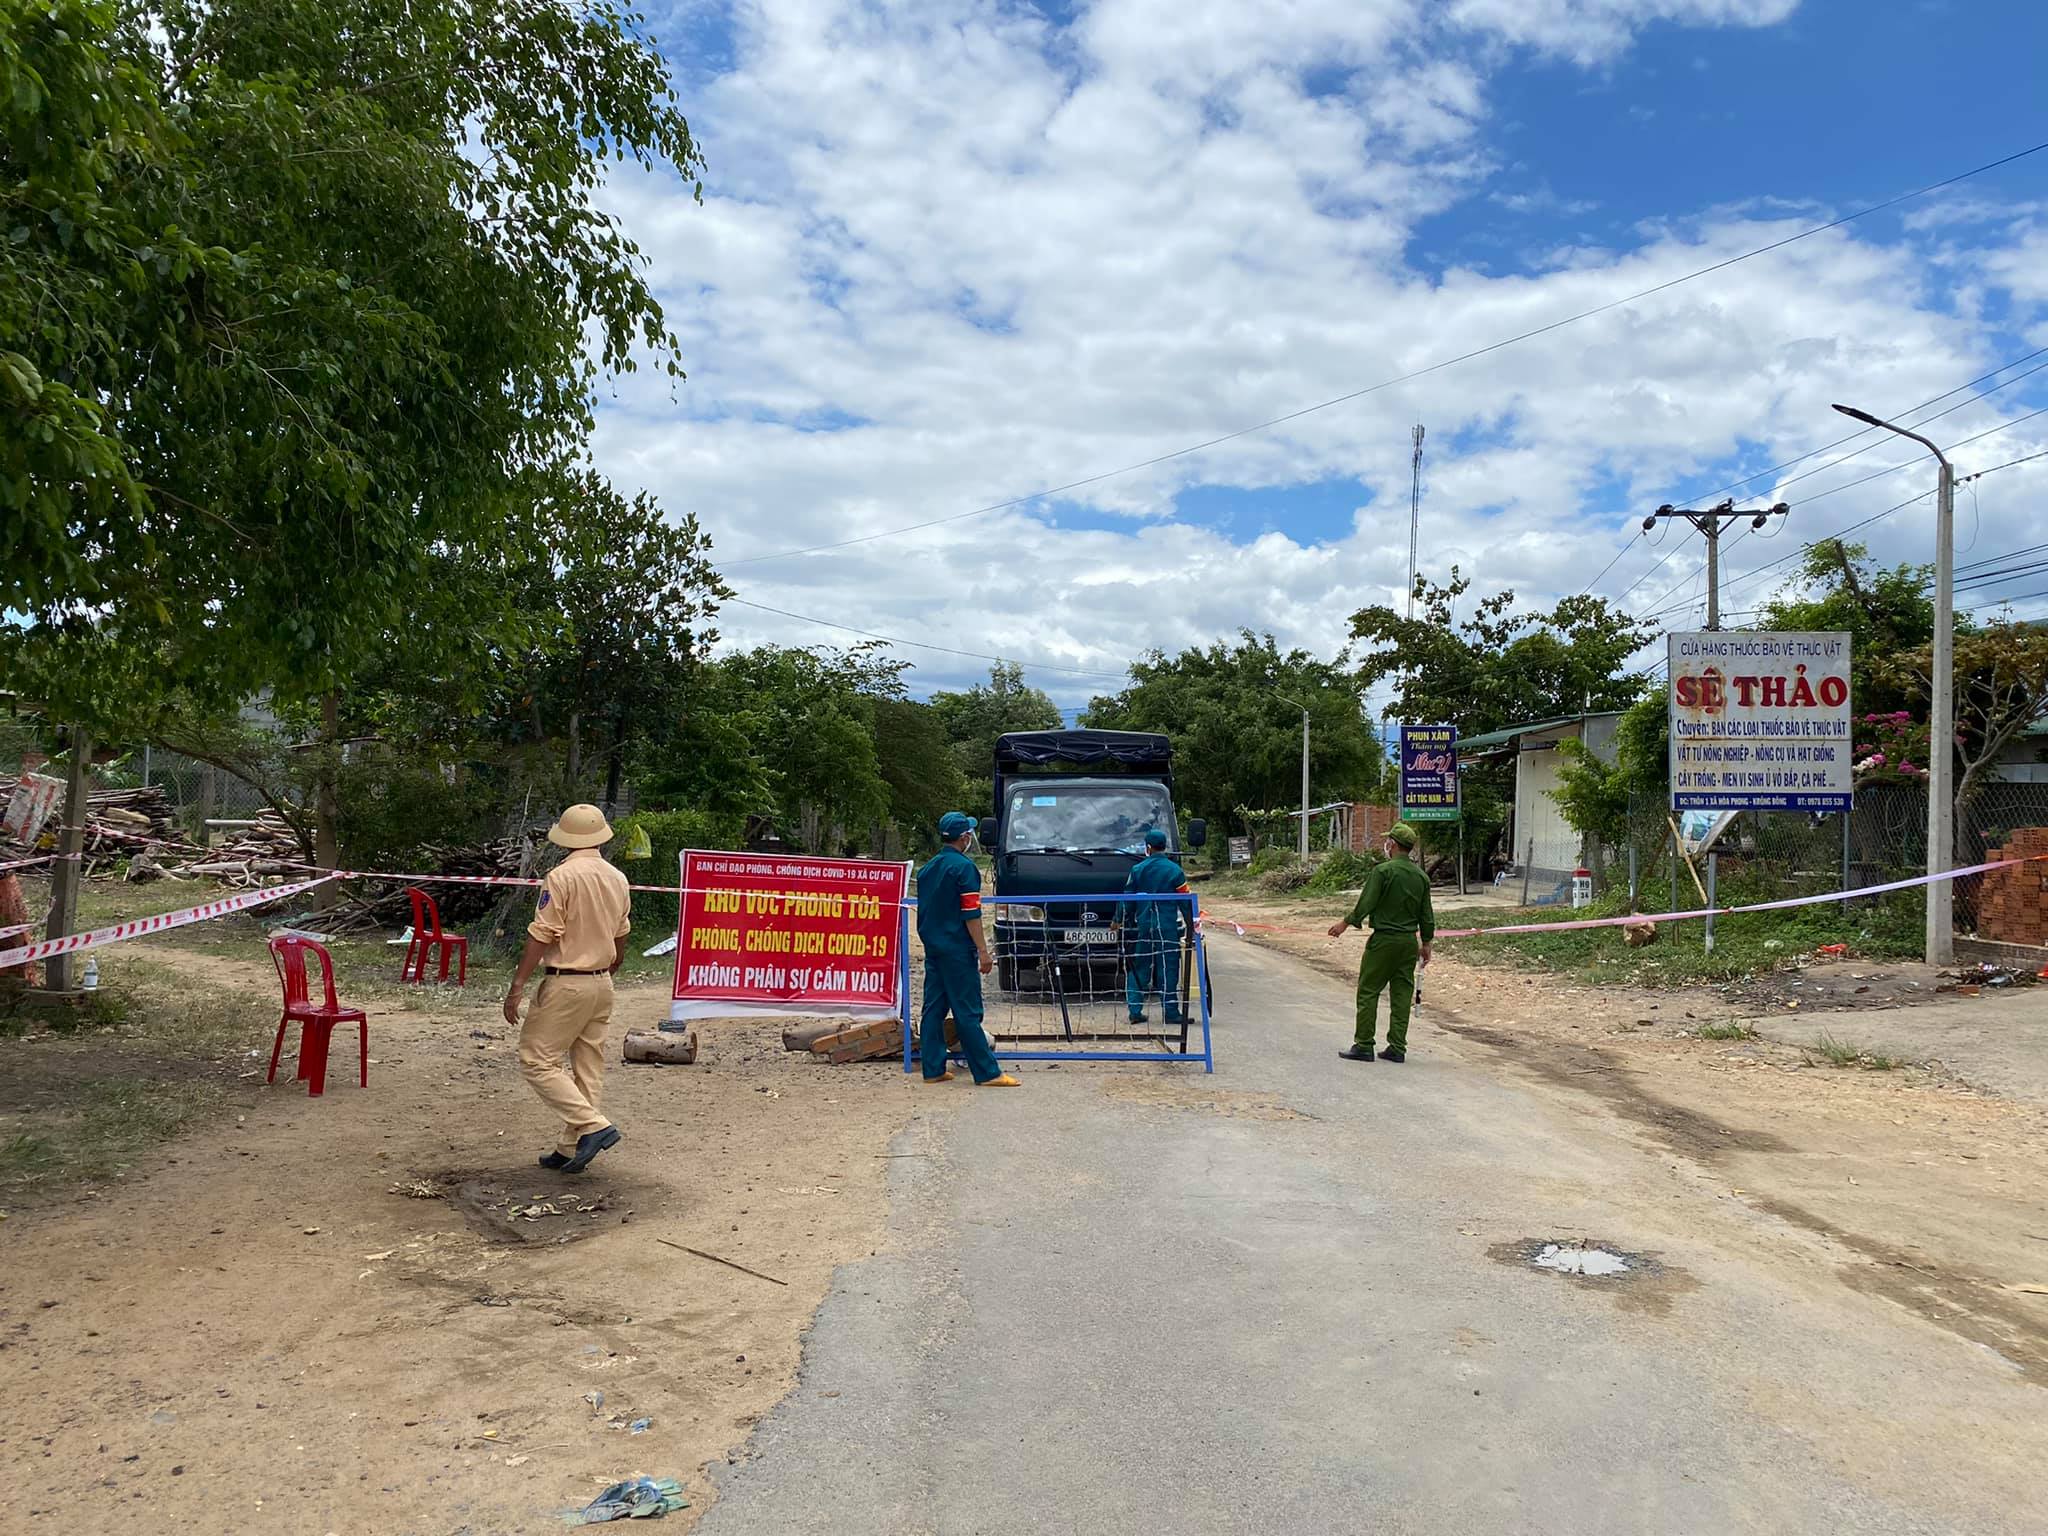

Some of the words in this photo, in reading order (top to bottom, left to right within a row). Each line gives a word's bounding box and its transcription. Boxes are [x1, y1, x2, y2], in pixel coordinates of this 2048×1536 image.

[1680, 638, 1699, 656] CỬA
[1729, 638, 1760, 656] THUỐC
[1676, 665, 1723, 714] SỆ
[1732, 663, 1848, 707] THẢO
[1407, 731, 1430, 741] PHUN
[1727, 718, 1742, 736] CÁC
[1761, 716, 1784, 736] THUỐC
[1785, 717, 1800, 736] BẢO
[1703, 744, 1722, 761] NÔNG
[1723, 744, 1749, 764] NGHIỆP
[1755, 744, 1775, 761] NÔNG
[1775, 747, 1785, 764] CỤ
[1787, 744, 1796, 761] VÀ
[1797, 747, 1811, 764] HẠT
[1813, 740, 1835, 761] GIỐNG
[1678, 769, 1692, 787] CÂY
[1722, 773, 1738, 787] MEN
[1739, 773, 1747, 787] VI
[1748, 773, 1764, 787] SINH
[696, 861, 713, 871] BAN
[729, 863, 745, 875] ĐẠO
[776, 863, 802, 876] CHỐNG
[822, 868, 857, 880] COVID-19
[869, 870, 881, 880] CƯ
[881, 872, 894, 881] PUI
[704, 887, 742, 913] KHU
[745, 889, 781, 919] VỰC
[783, 890, 843, 918] PHONG
[847, 888, 880, 920] TỎA
[691, 923, 742, 955] PHÒNG,
[746, 922, 791, 953] CHỐNG
[793, 932, 825, 957] DỊCH
[828, 933, 888, 957] COVID-19
[688, 961, 740, 988] KHÔNG
[744, 964, 785, 992] PHẬN
[789, 967, 812, 994] SỰ
[813, 962, 847, 991] CẤM
[851, 967, 885, 993] VÀO!
